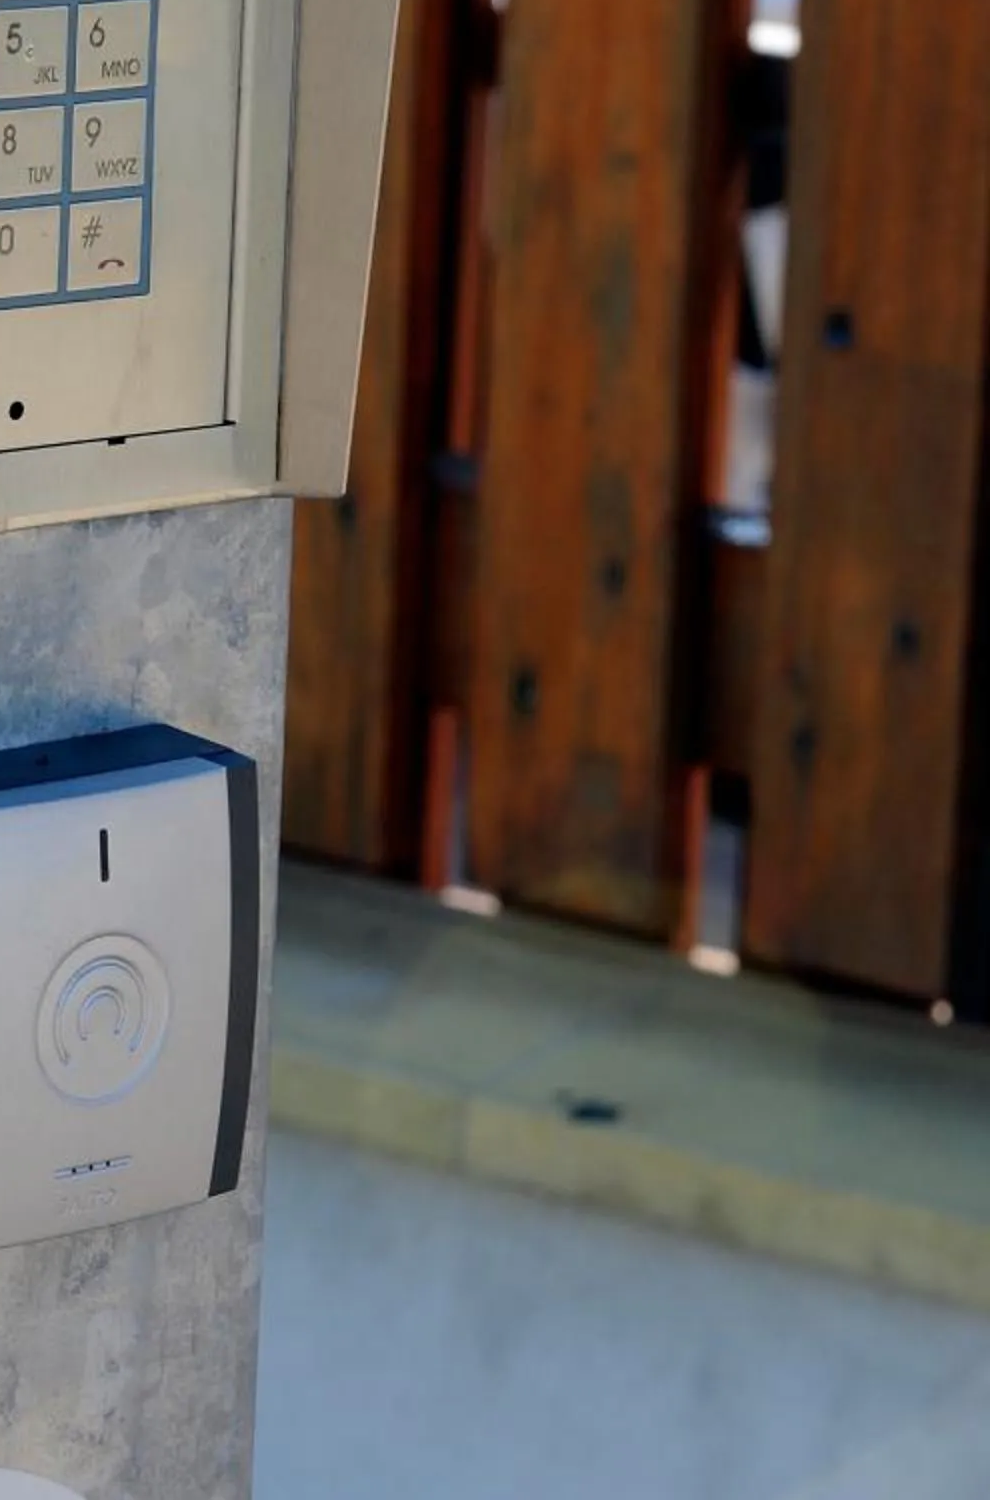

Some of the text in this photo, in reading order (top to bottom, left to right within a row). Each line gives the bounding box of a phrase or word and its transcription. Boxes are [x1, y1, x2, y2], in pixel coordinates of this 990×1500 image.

[5, 23, 22, 55] 5
[89, 17, 105, 47] 6
[33, 67, 59, 85] JKL
[100, 58, 141, 79] MNO
[2, 124, 17, 155] 8
[85, 117, 101, 148] 9
[28, 166, 54, 184] TUV
[96, 157, 138, 179] WXYZ
[82, 215, 103, 249] #
